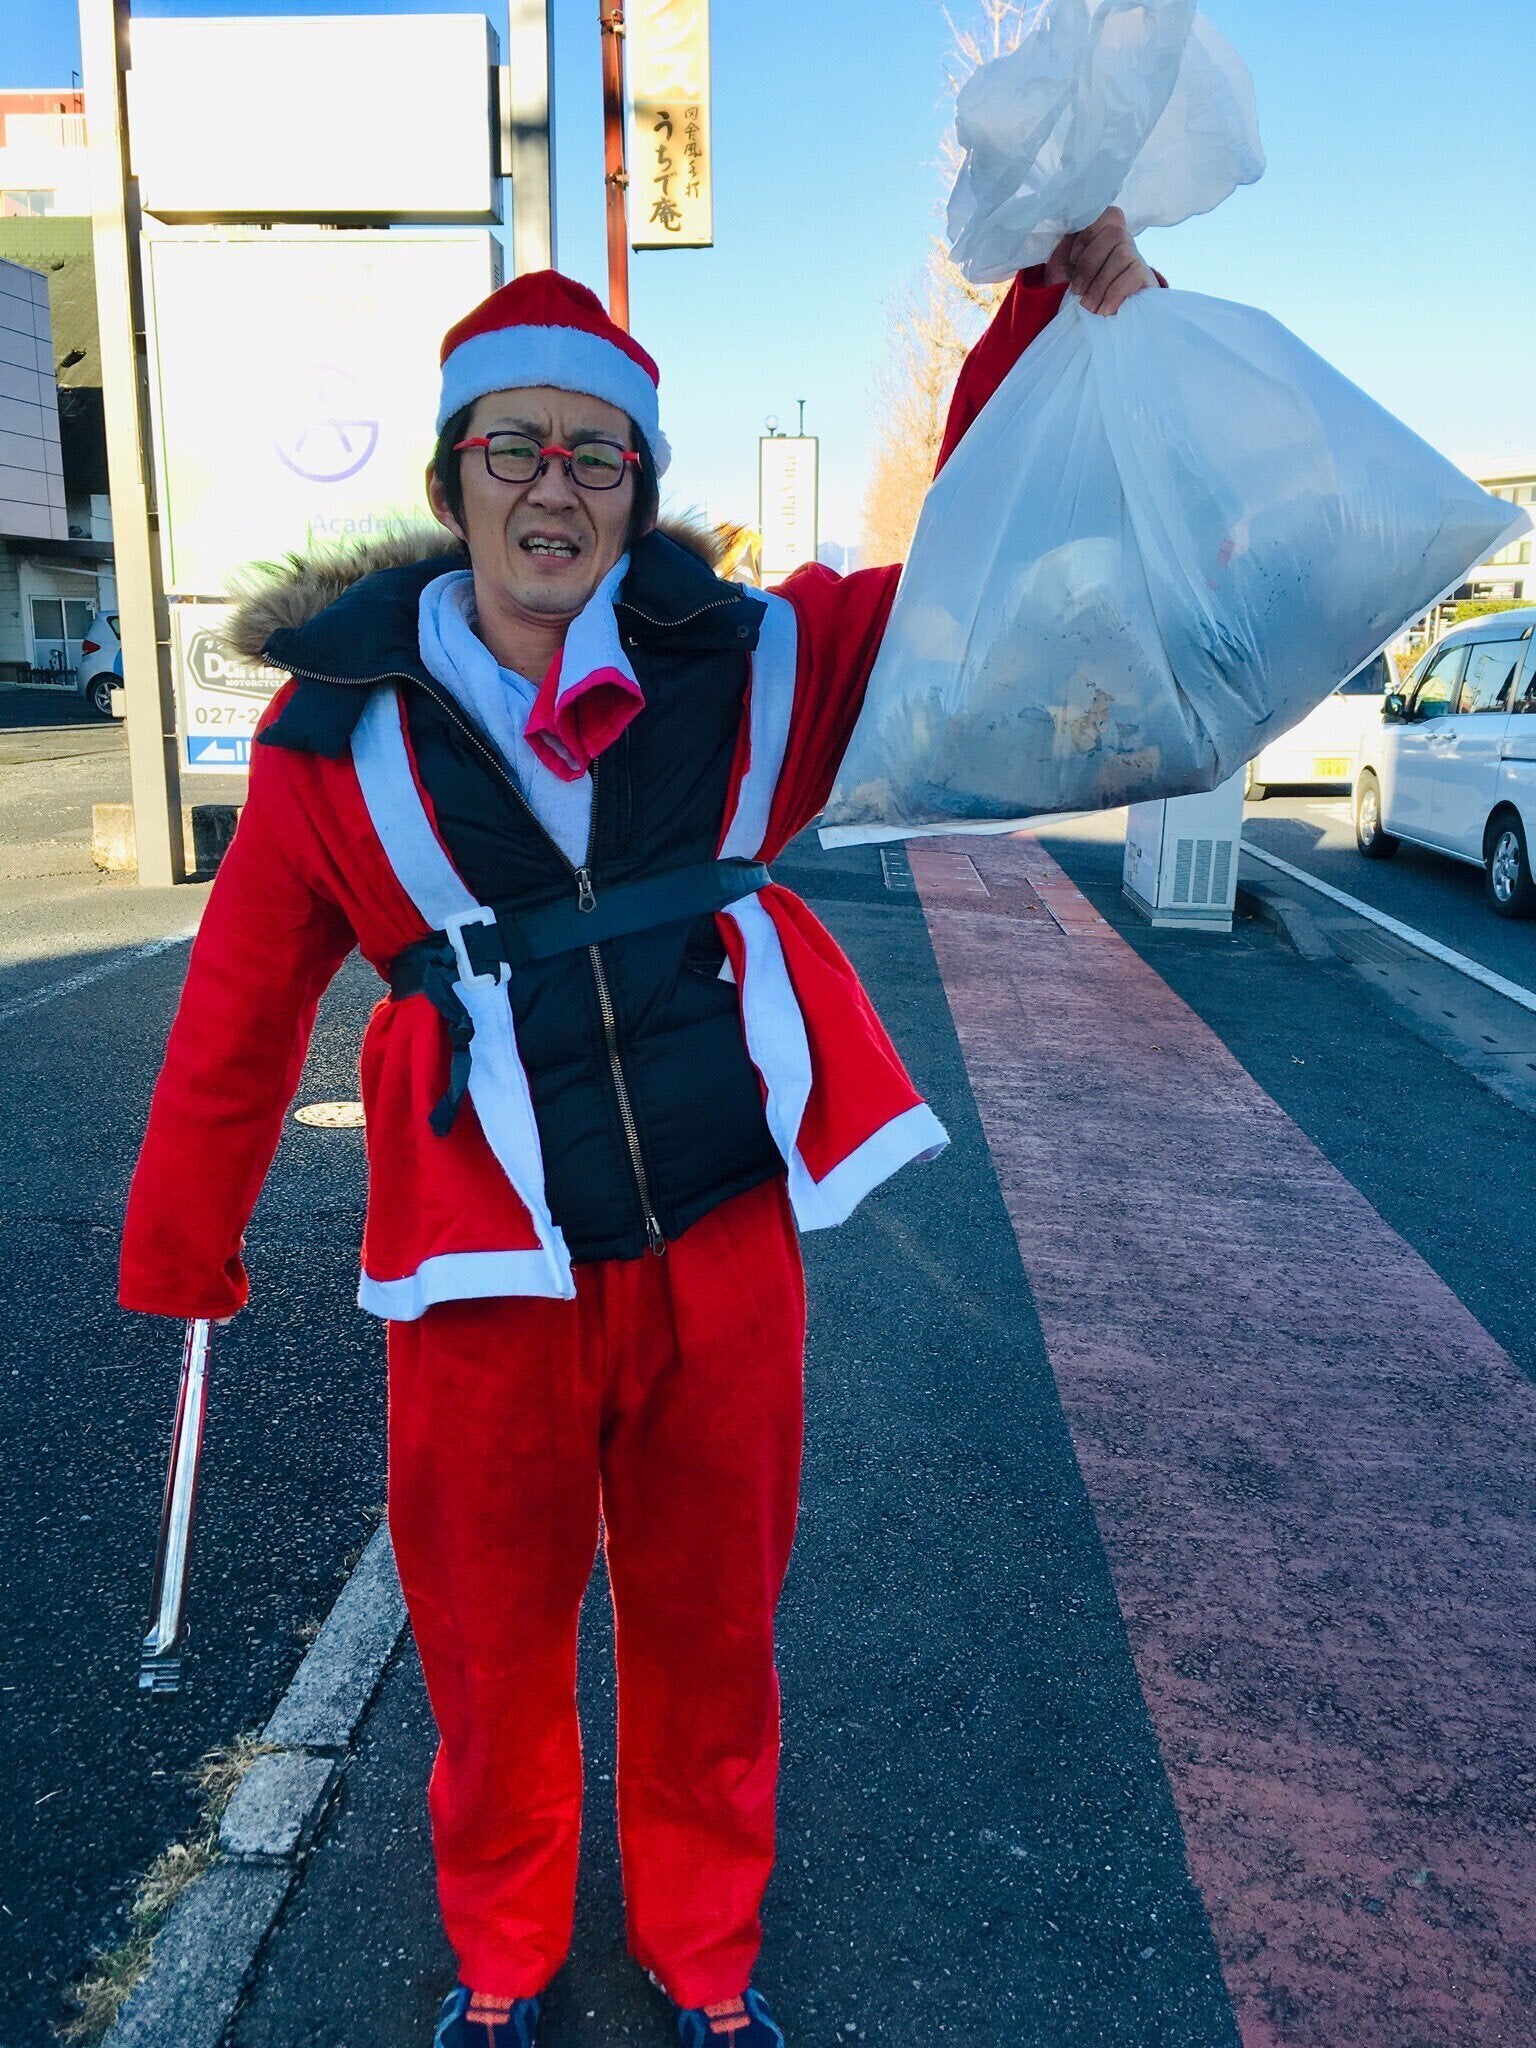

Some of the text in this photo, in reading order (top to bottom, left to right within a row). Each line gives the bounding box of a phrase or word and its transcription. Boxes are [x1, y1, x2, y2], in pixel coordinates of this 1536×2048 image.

[649, 110, 683, 232] うちで庵
[225, 679, 285, 688] MOTORCYCL
